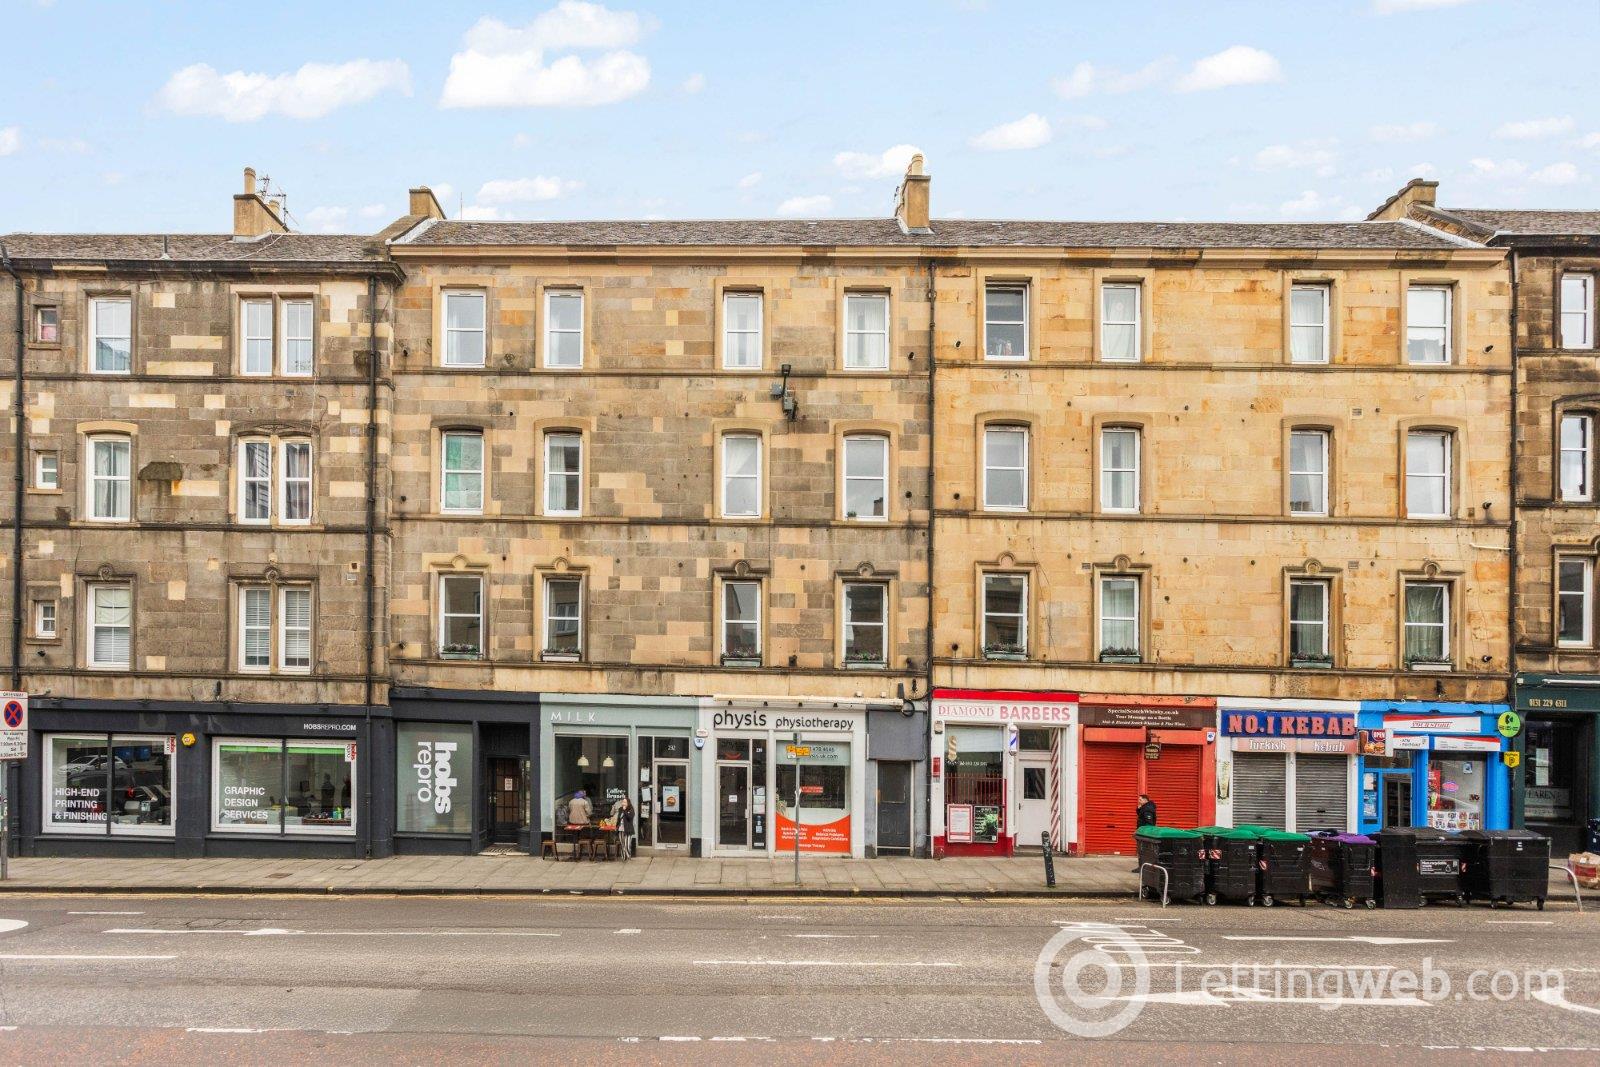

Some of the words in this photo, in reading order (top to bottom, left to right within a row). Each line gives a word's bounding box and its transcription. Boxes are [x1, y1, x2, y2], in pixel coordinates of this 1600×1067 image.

[1529, 698, 1540, 706] 0131
[550, 711, 597, 722] MILK
[938, 706, 994, 716] DIAMOND
[1000, 706, 1070, 720] BARBERS
[713, 710, 766, 728] physis
[776, 716, 854, 730] physiotherapy
[1280, 716, 1357, 736] KEBAB
[1249, 740, 1286, 750] Turkish
[1314, 742, 1346, 752] Kebab
[413, 742, 432, 802] repro
[434, 742, 458, 814] hobs
[55, 788, 100, 797] HIGH-END
[224, 786, 266, 795] GRAPHIC
[55, 800, 98, 808] PRINTING
[224, 798, 258, 807] DESIGN
[63, 812, 108, 821] FINISHING
[224, 809, 269, 819] SERVICES
